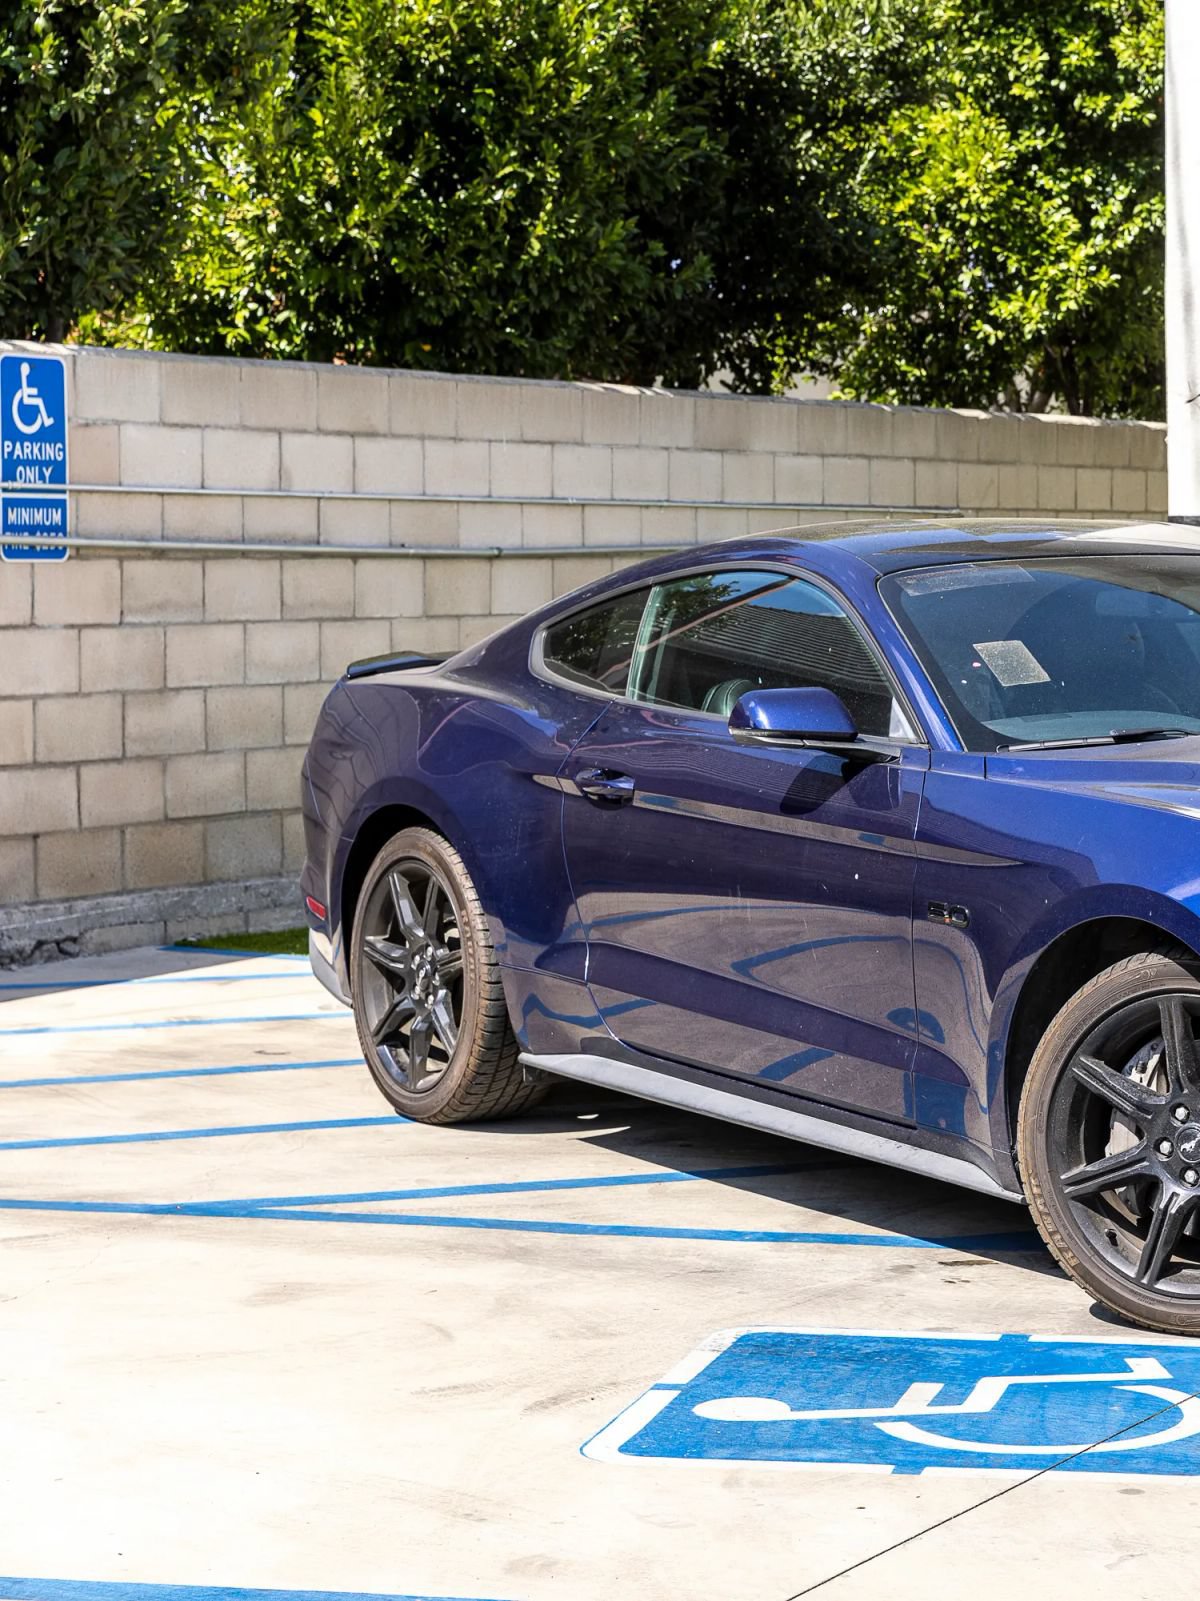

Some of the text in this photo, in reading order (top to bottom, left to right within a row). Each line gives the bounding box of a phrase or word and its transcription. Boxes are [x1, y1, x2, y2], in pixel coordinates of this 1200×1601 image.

[3, 440, 64, 461] PARKING
[16, 465, 54, 484] ONLY
[7, 507, 62, 526] MINIMUM
